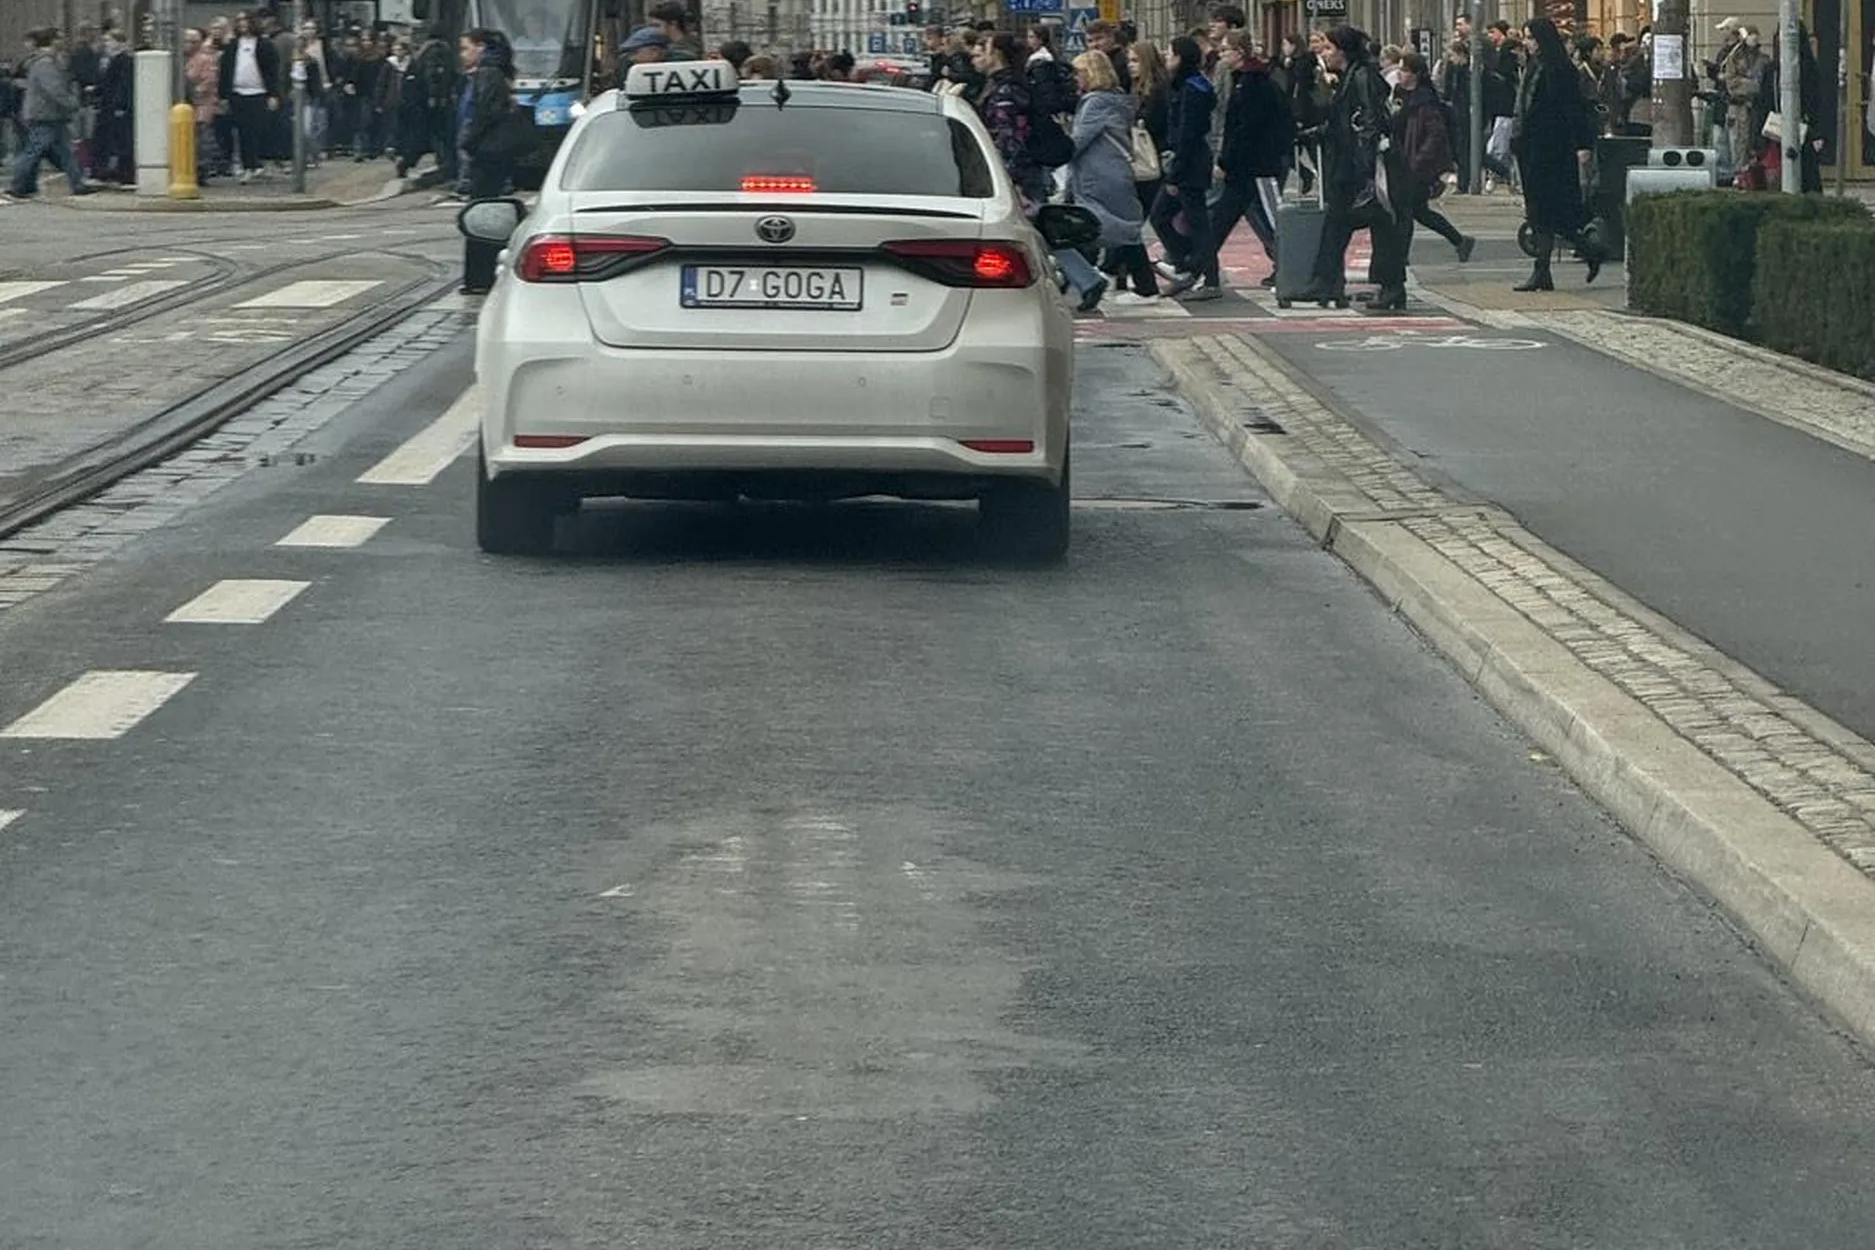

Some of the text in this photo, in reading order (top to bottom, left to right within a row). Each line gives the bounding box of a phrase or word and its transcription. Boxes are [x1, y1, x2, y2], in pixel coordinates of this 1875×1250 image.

[642, 68, 721, 93] TAXI
[706, 269, 846, 300] D7 GOGA
